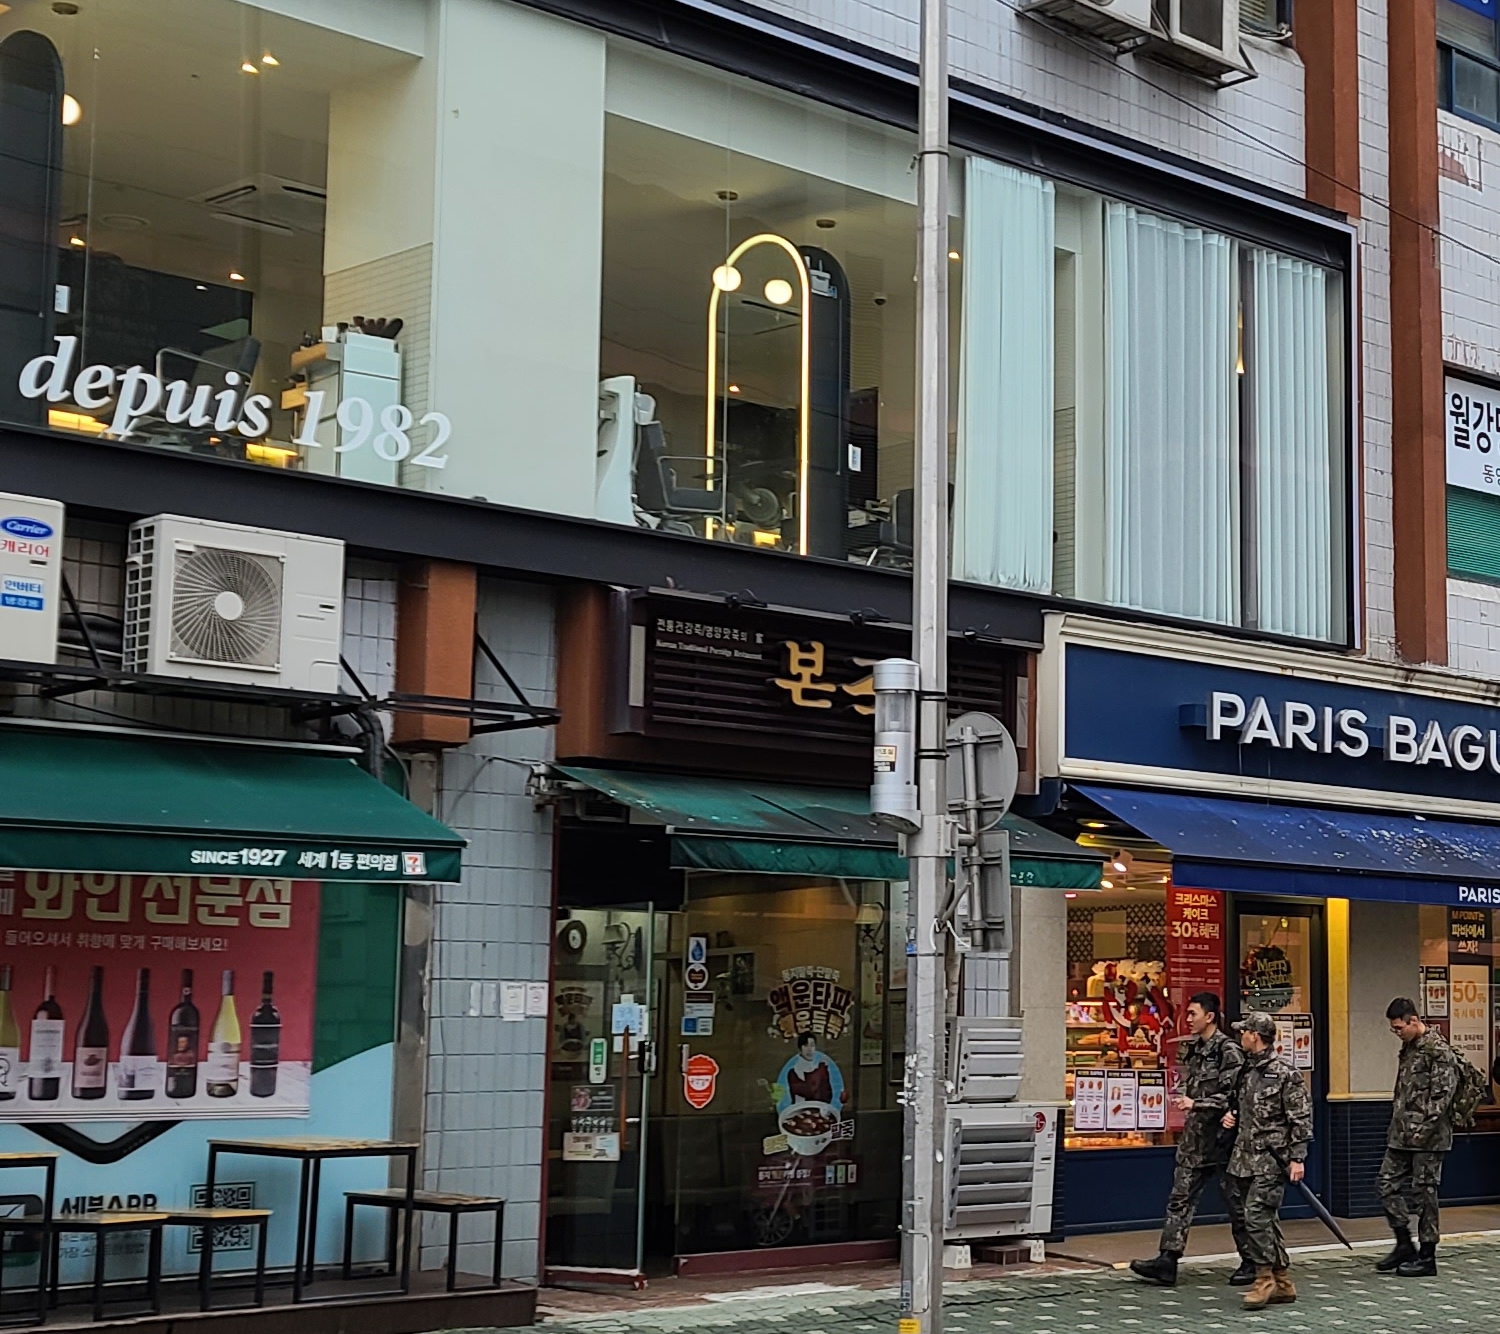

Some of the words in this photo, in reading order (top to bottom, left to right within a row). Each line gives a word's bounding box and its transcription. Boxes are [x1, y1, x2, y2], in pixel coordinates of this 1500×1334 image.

[18, 335, 273, 441] depuis
[291, 389, 452, 469] 1982
[6, 520, 49, 535] Carrier
[0, 539, 50, 558] 캐리어
[4, 579, 42, 594] 인버터
[1207, 690, 1370, 760] PARIS
[297, 850, 329, 869] 세계
[329, 848, 355, 871] 1등
[355, 852, 399, 872] 편의점
[1174, 892, 1218, 907] 크리스마스
[1182, 907, 1209, 921] 케이크
[1199, 921, 1220, 940] 혜택
[1451, 923, 1486, 938] 파바에서
[5, 929, 72, 947] 들어오셔서
[119, 934, 145, 949] 맞게
[150, 935, 228, 952] 구매해보세요!
[1457, 939, 1479, 954] 쓰자!
[1256, 958, 1288, 973] Merry
[1452, 980, 1487, 1004] 50%
